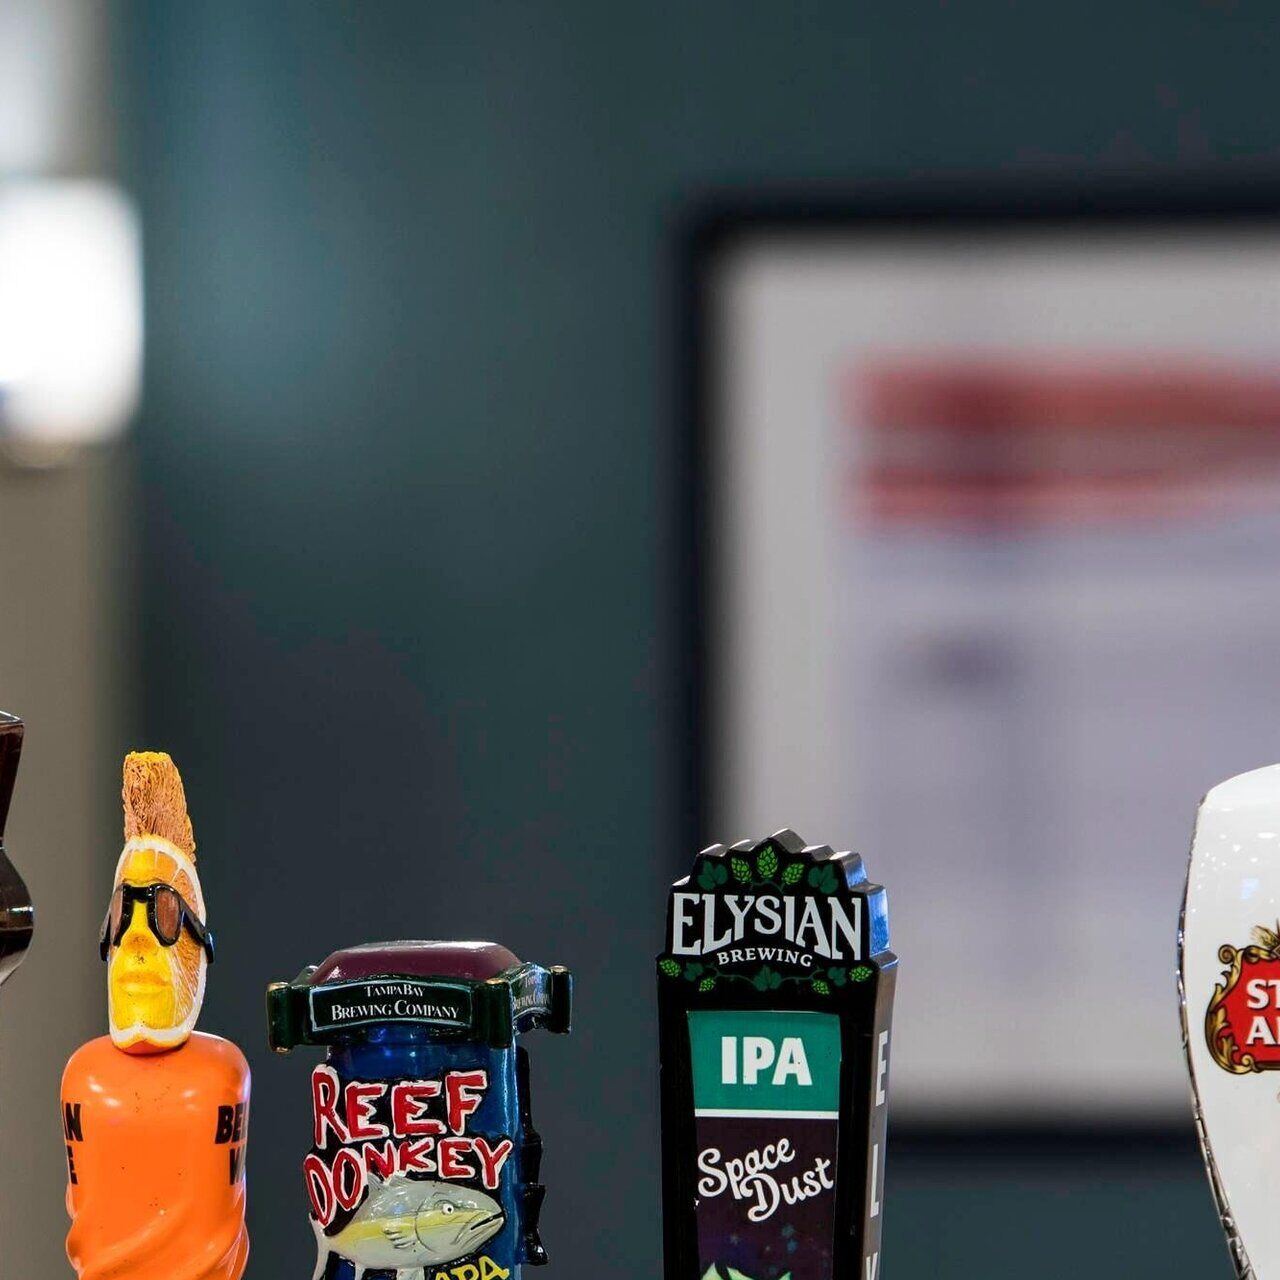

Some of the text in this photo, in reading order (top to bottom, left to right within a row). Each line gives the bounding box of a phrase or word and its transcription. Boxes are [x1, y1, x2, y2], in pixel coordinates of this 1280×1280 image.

[672, 892, 862, 961] ELYSIAN
[717, 947, 813, 968] BREWING
[331, 999, 459, 1021] BREWING COMPANY
[364, 984, 425, 998] TAMPA BAY
[721, 1036, 812, 1086] IPA
[311, 1064, 488, 1150] REEF
[303, 1136, 514, 1230] DONKEY
[697, 1137, 796, 1199] Space
[739, 1157, 834, 1223] Dust
